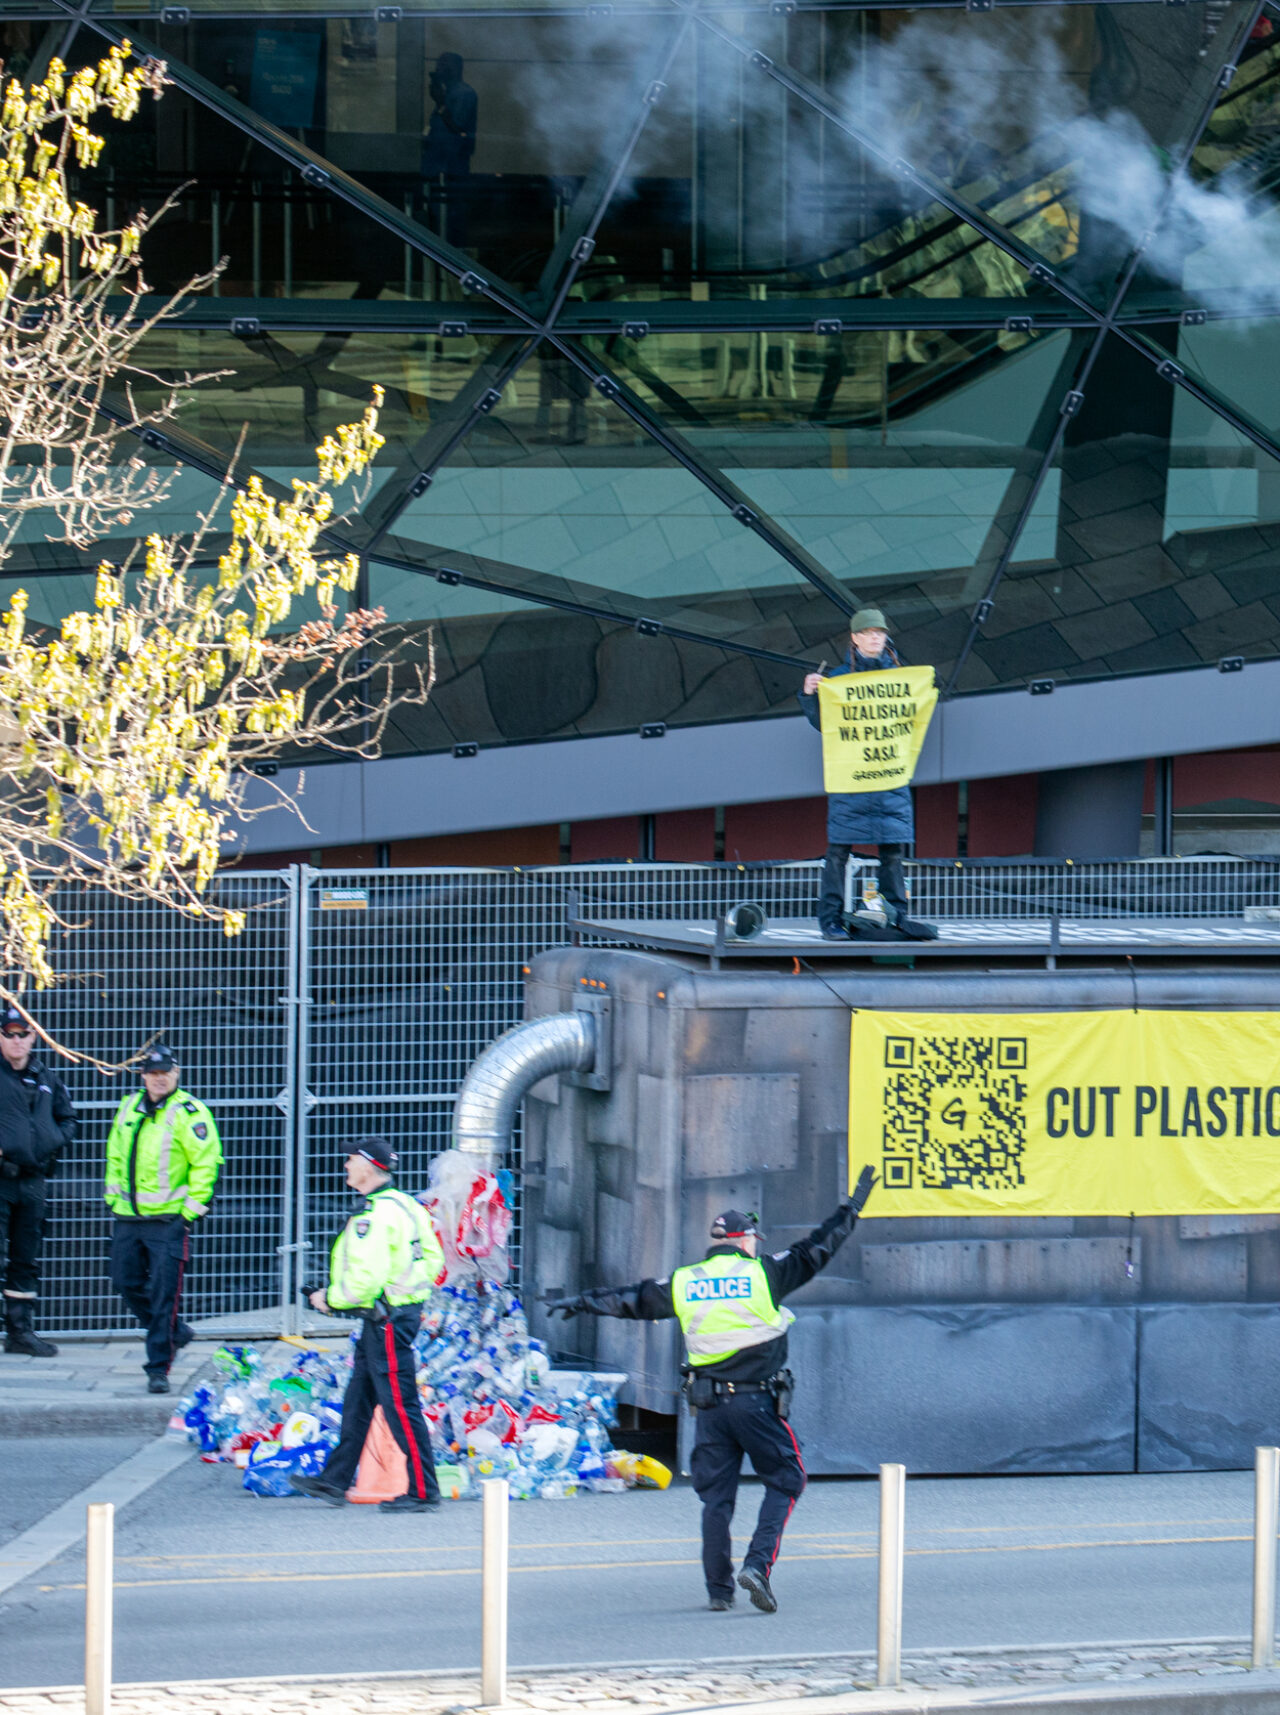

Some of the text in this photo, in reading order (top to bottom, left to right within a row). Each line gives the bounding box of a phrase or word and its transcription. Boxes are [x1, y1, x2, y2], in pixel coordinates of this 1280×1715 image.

[846, 683, 911, 701] PUNGUZA
[838, 726, 860, 742] WA
[1046, 1085, 1121, 1138] CUT
[687, 1278, 750, 1300] POLICE
